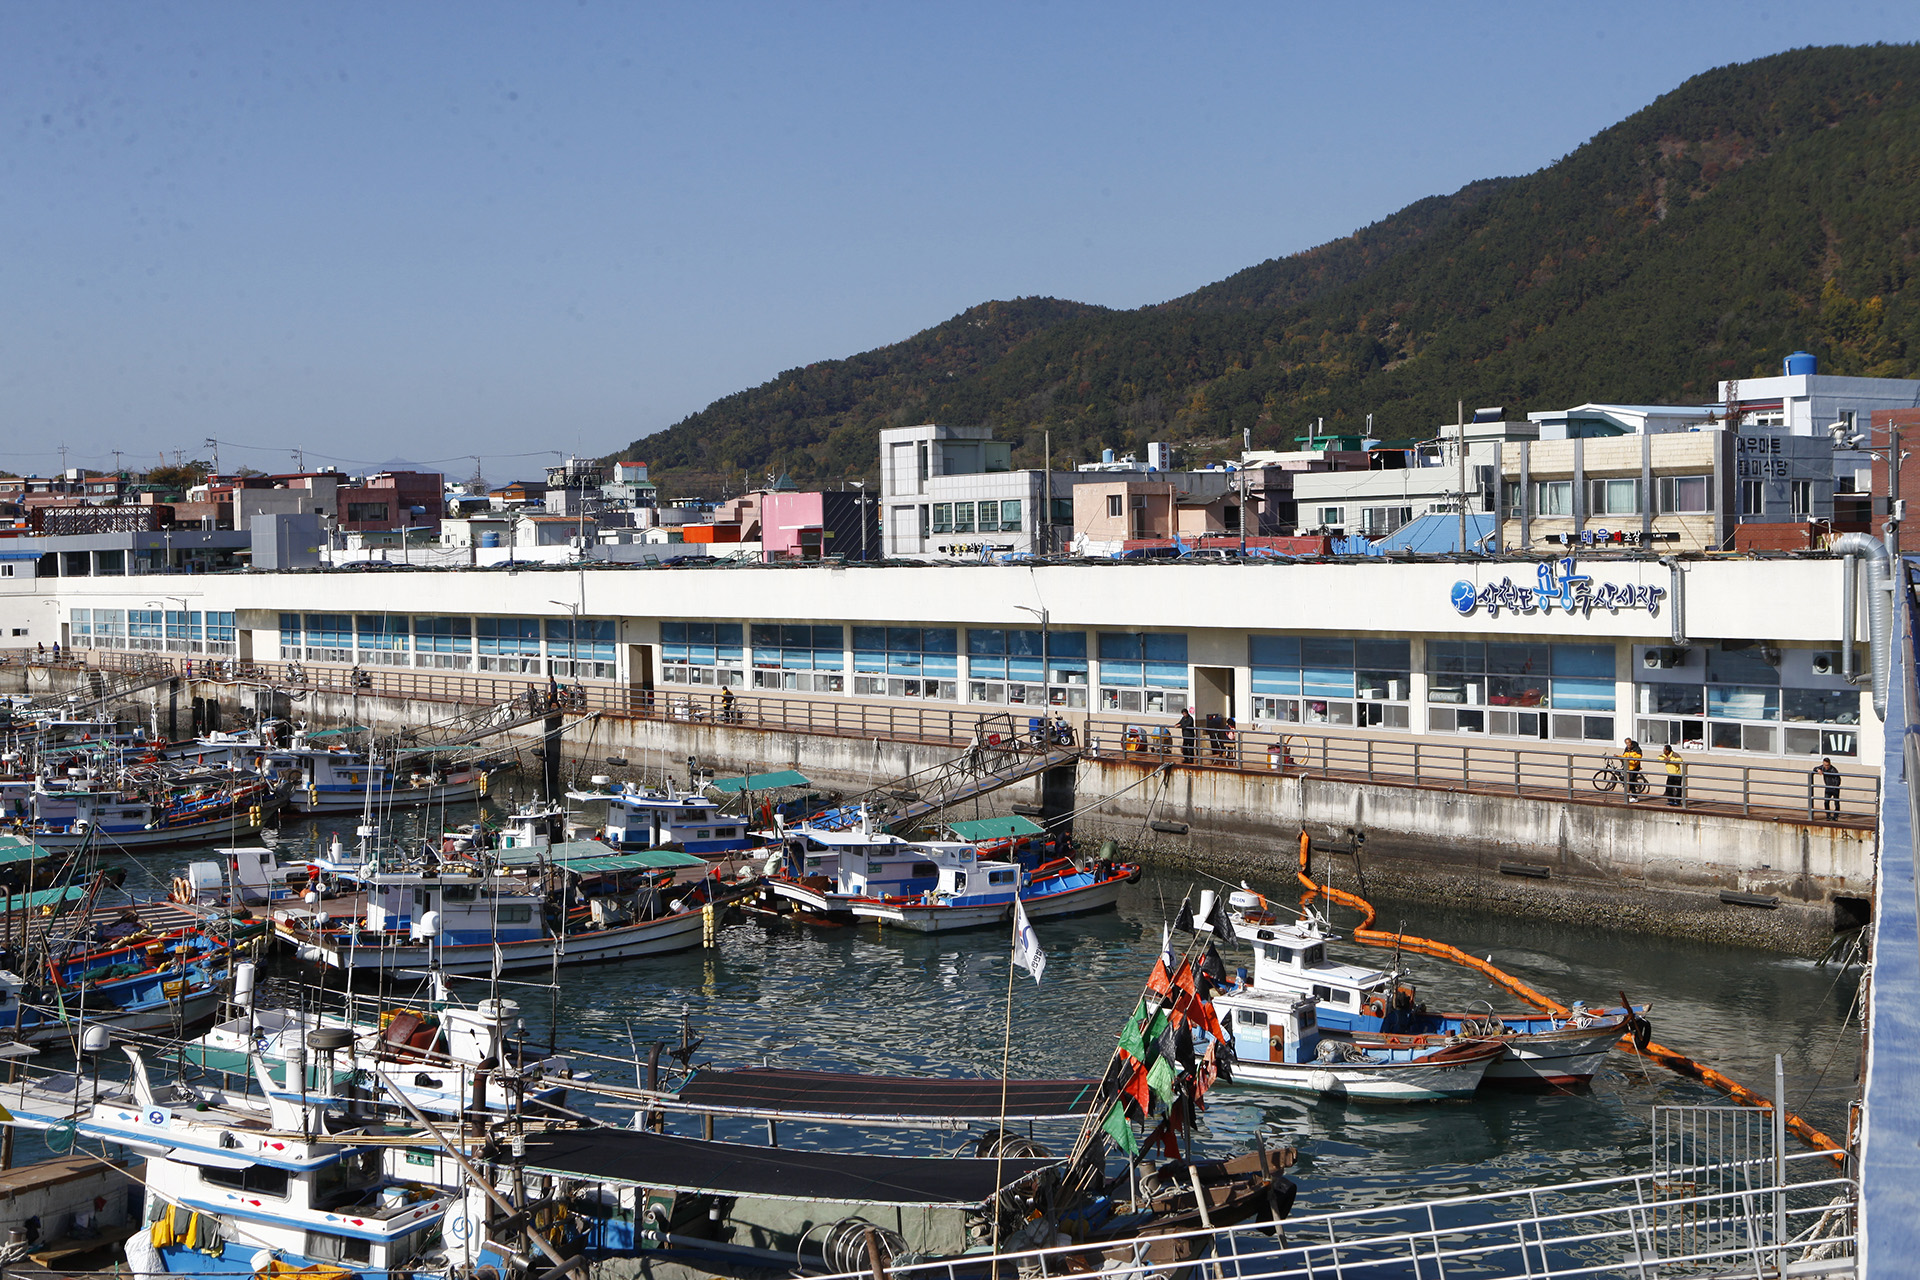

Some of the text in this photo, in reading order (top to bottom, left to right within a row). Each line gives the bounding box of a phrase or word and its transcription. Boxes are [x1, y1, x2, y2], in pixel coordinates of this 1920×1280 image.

[1477, 557, 1664, 615] 삼천포 용궁 수산시장
